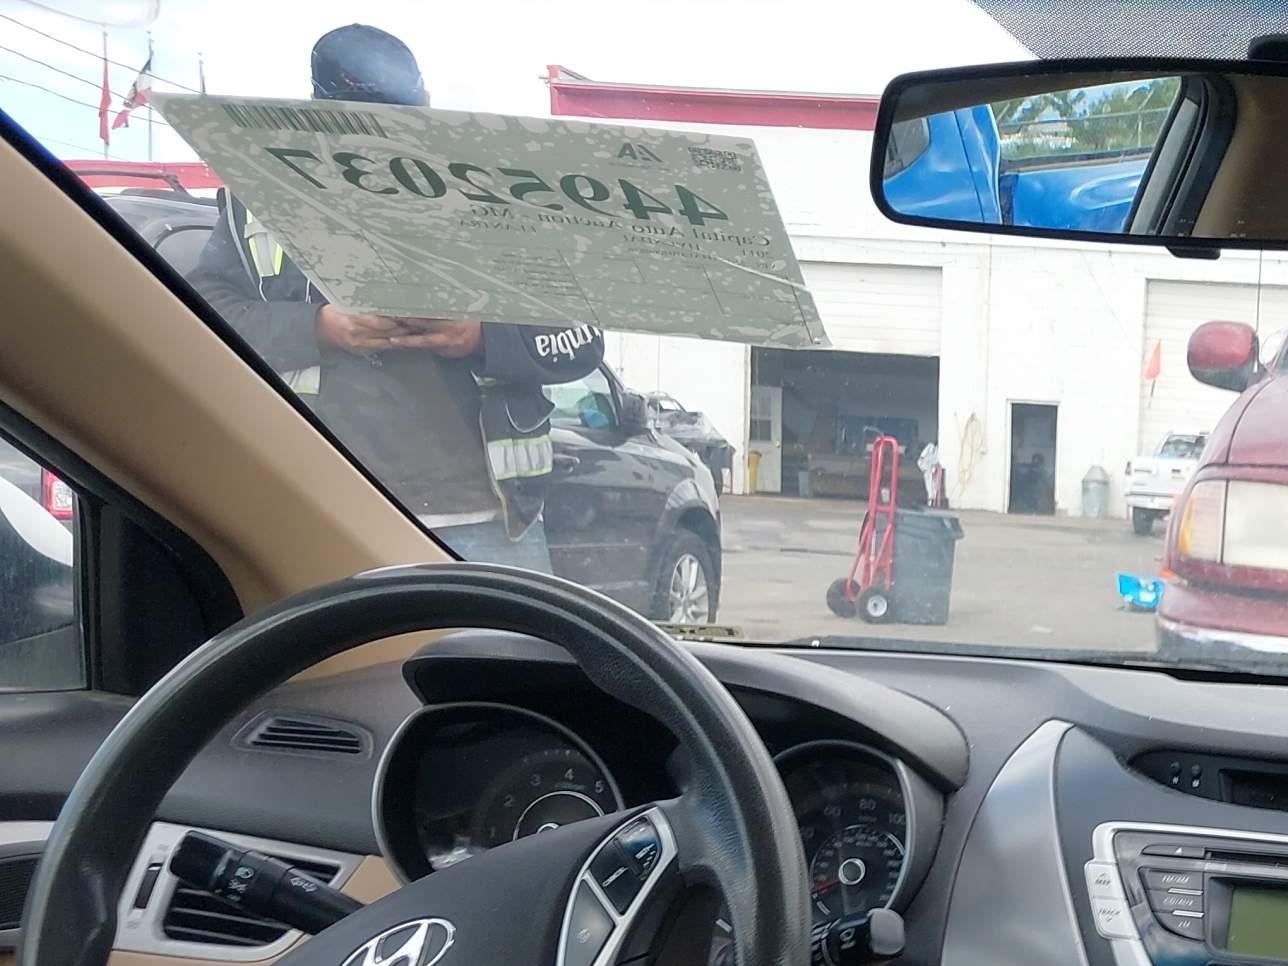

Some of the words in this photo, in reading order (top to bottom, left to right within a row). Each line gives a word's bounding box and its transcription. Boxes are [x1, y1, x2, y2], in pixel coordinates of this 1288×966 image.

[531, 774, 541, 786] 3
[564, 768, 574, 781] 4
[594, 780, 604, 793] 5
[504, 795, 513, 808] 2
[859, 798, 876, 811] 80
